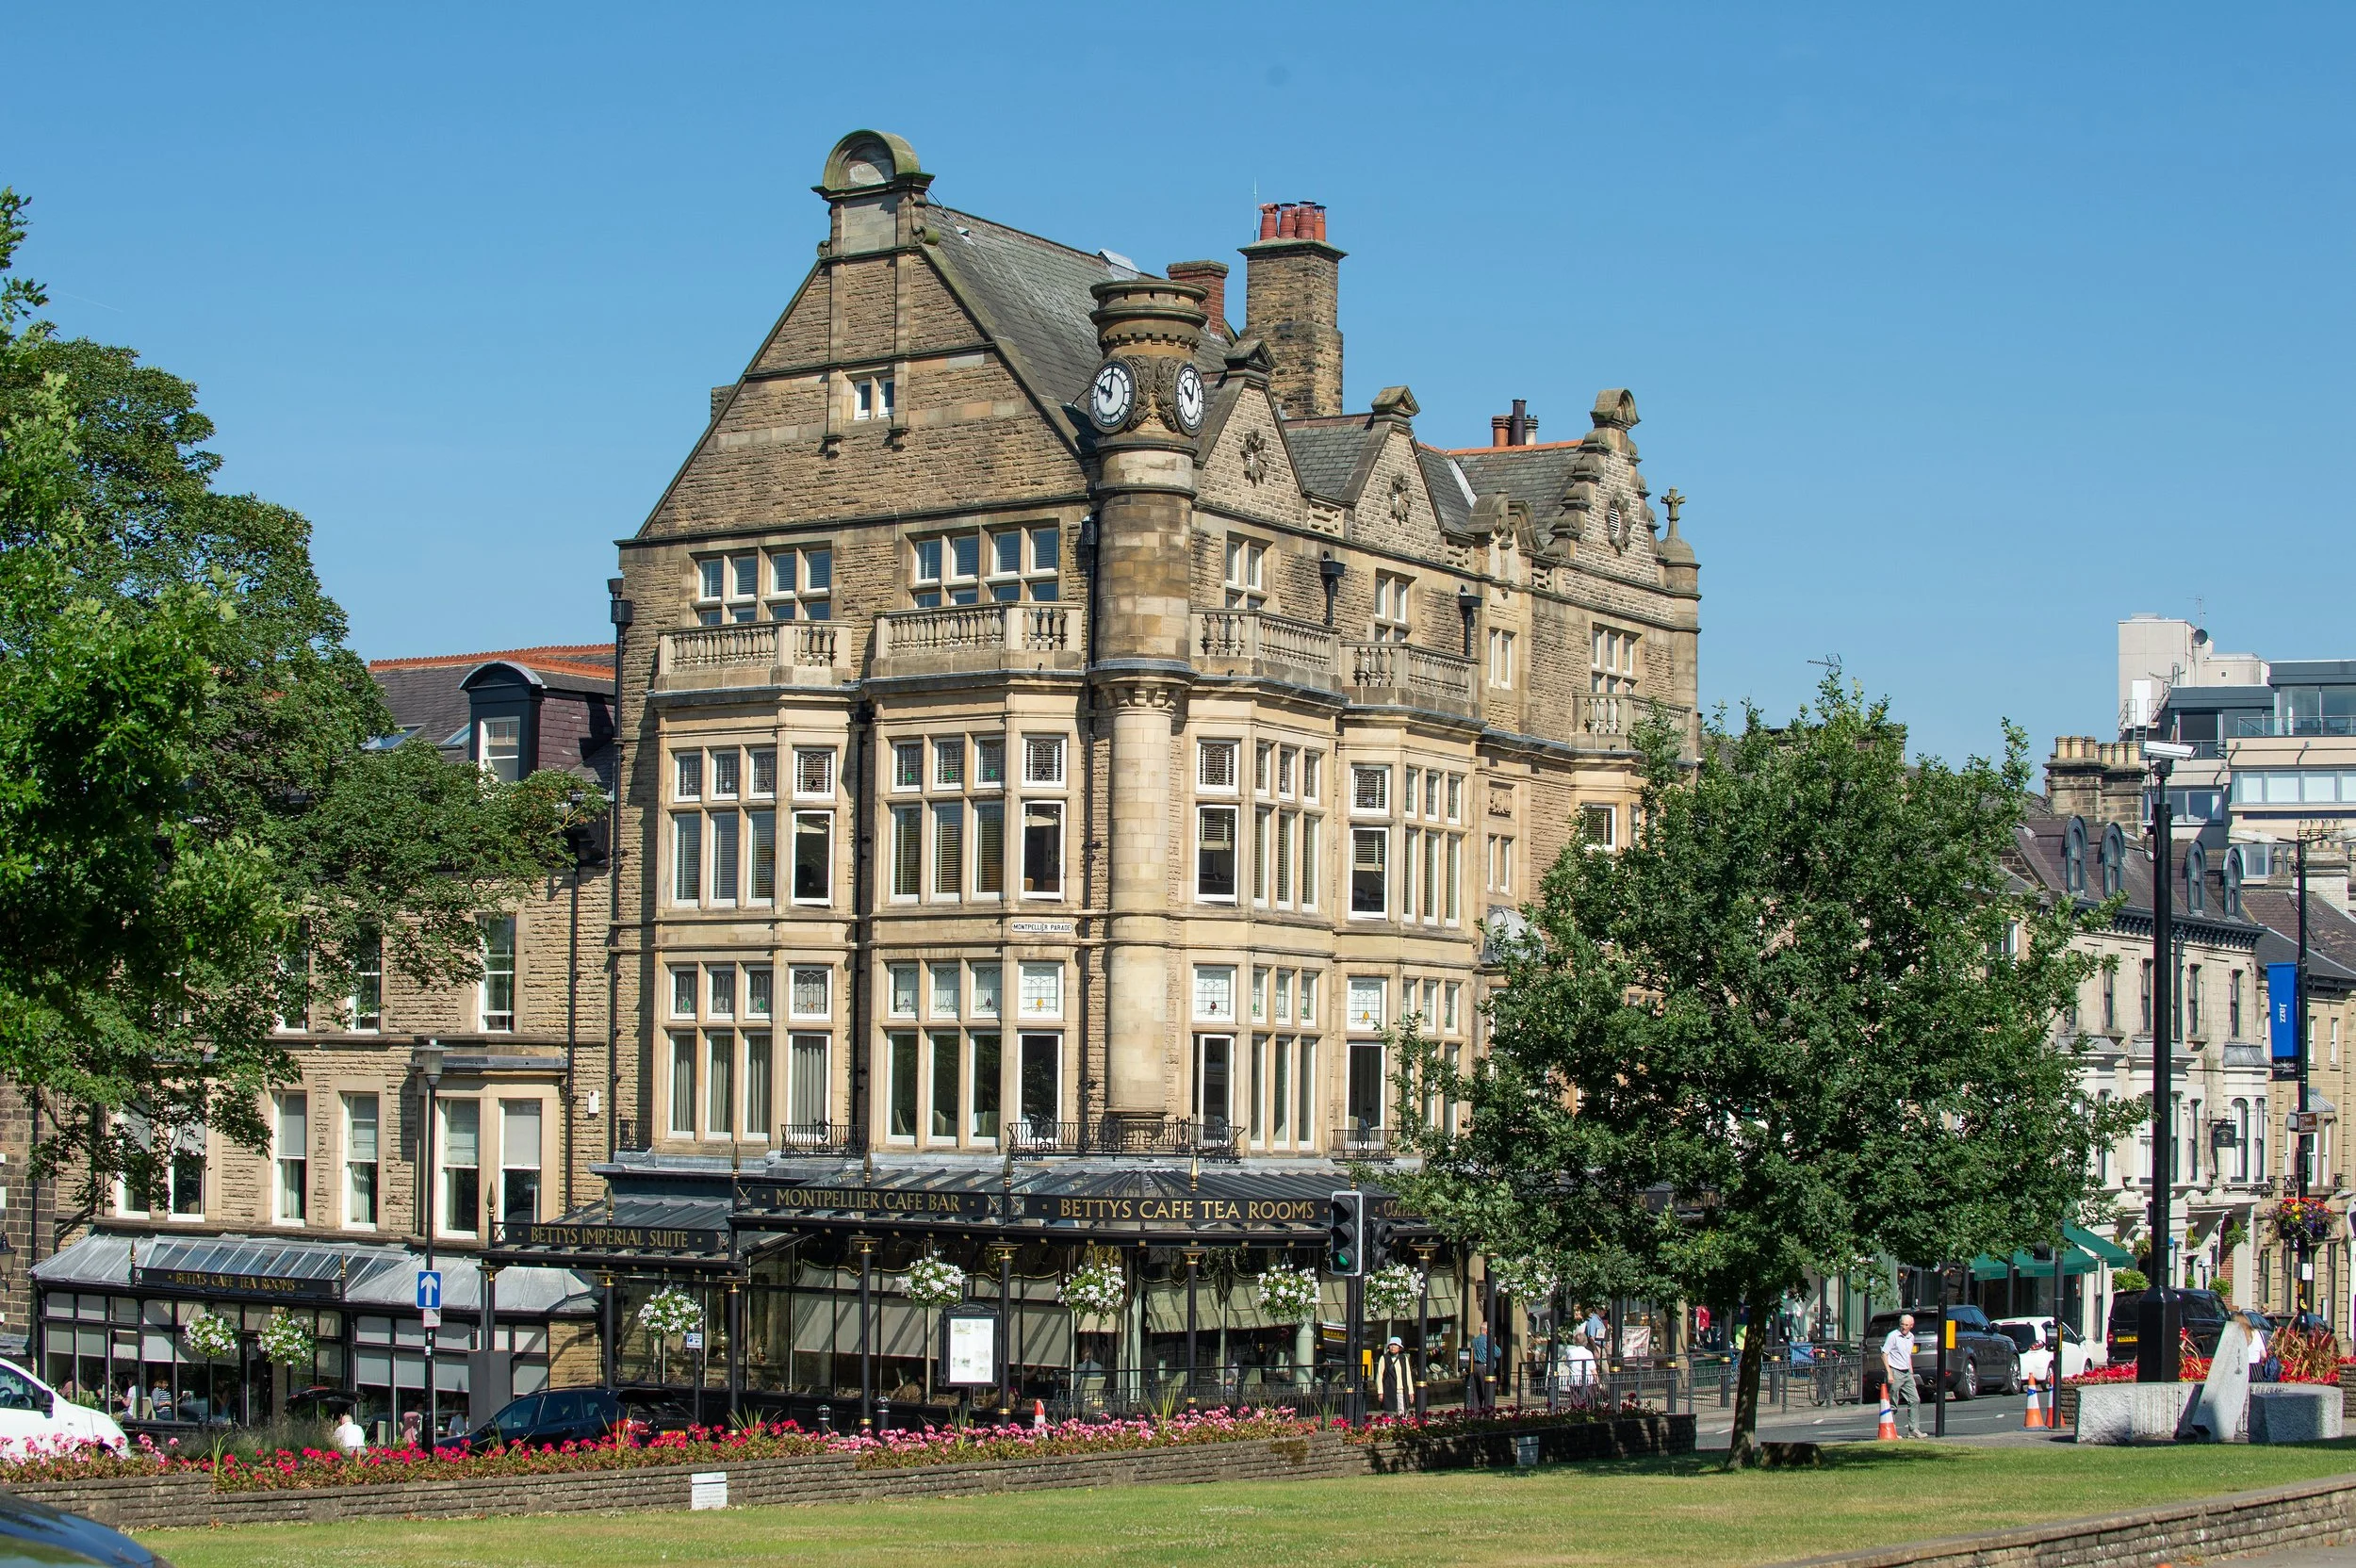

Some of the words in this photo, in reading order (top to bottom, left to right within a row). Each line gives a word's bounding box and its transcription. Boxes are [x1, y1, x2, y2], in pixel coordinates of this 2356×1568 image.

[2279, 1003, 2287, 1022] Jazz
[776, 1188, 880, 1210] MONTPELLIER
[884, 1192, 924, 1211] CAFE
[927, 1194, 960, 1213] BAR
[1060, 1199, 1132, 1218] BETTYS
[1138, 1200, 1194, 1219] CAFE
[1200, 1200, 1241, 1220] TEA
[1248, 1200, 1315, 1220] ROOMS
[531, 1226, 578, 1244] BETTYS
[581, 1229, 645, 1247] IMPERIAL
[648, 1230, 689, 1249] SUITE
[175, 1272, 207, 1286] BETTYS
[211, 1274, 234, 1288] CAFE
[239, 1276, 256, 1289] TEA
[261, 1277, 295, 1291] ROOMS
